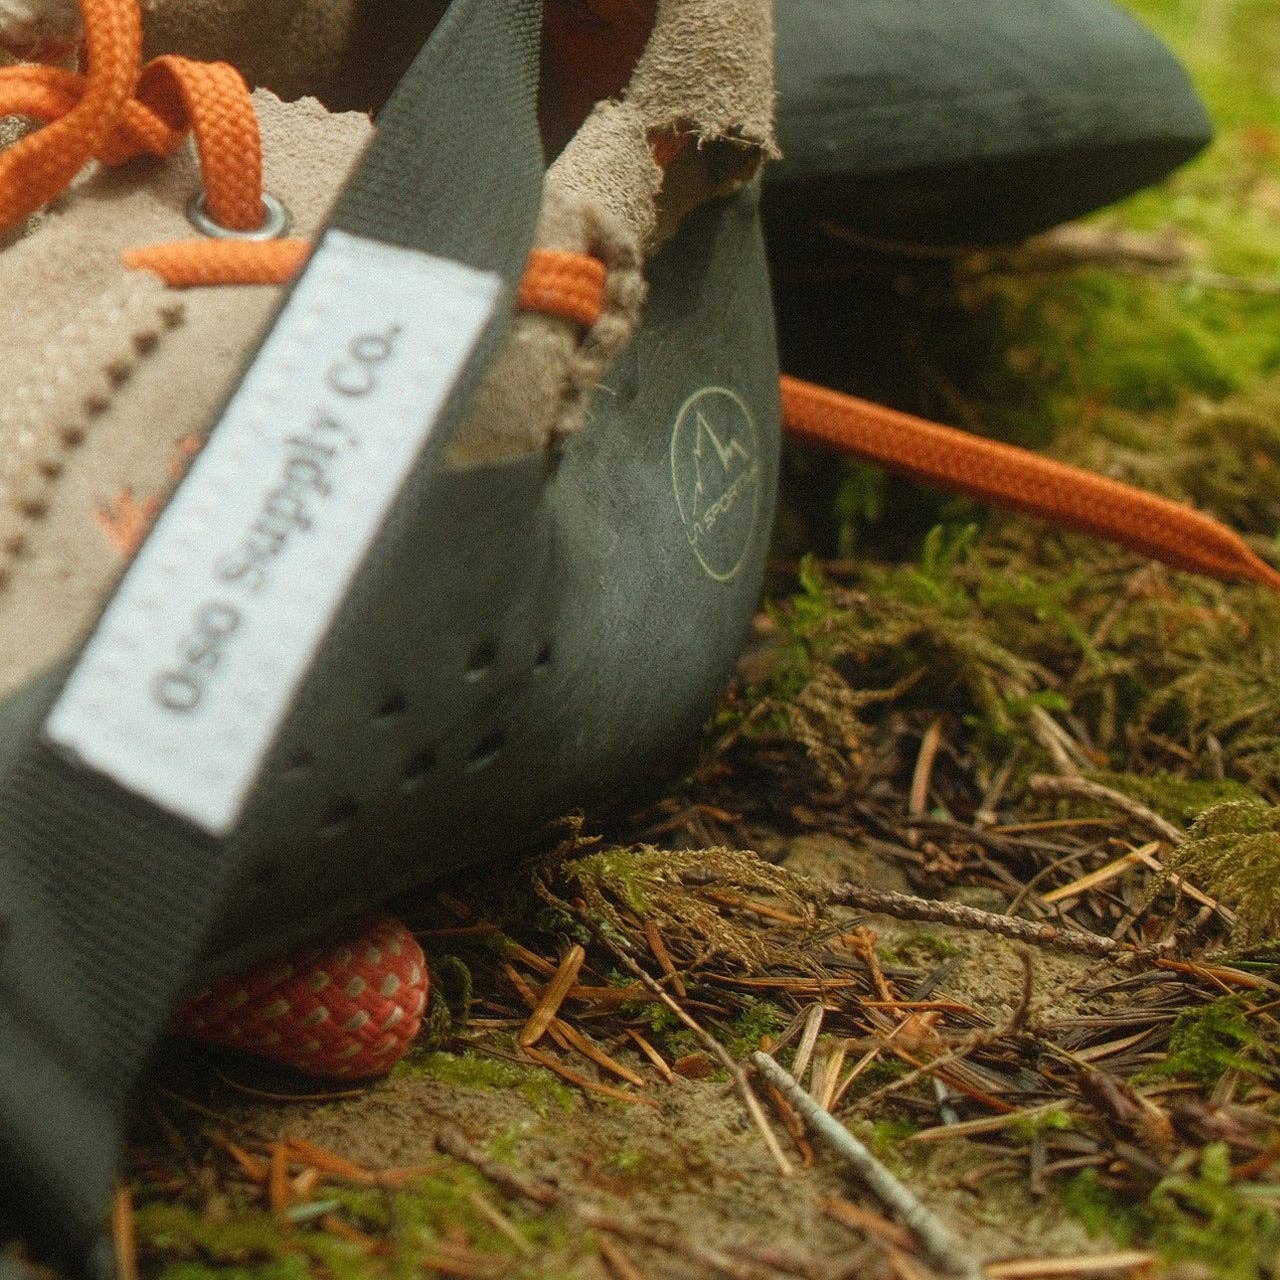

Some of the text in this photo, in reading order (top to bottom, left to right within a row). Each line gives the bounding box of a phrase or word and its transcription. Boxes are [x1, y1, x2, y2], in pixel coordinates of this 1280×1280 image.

[151, 322, 402, 714] Oso Supply Co.
